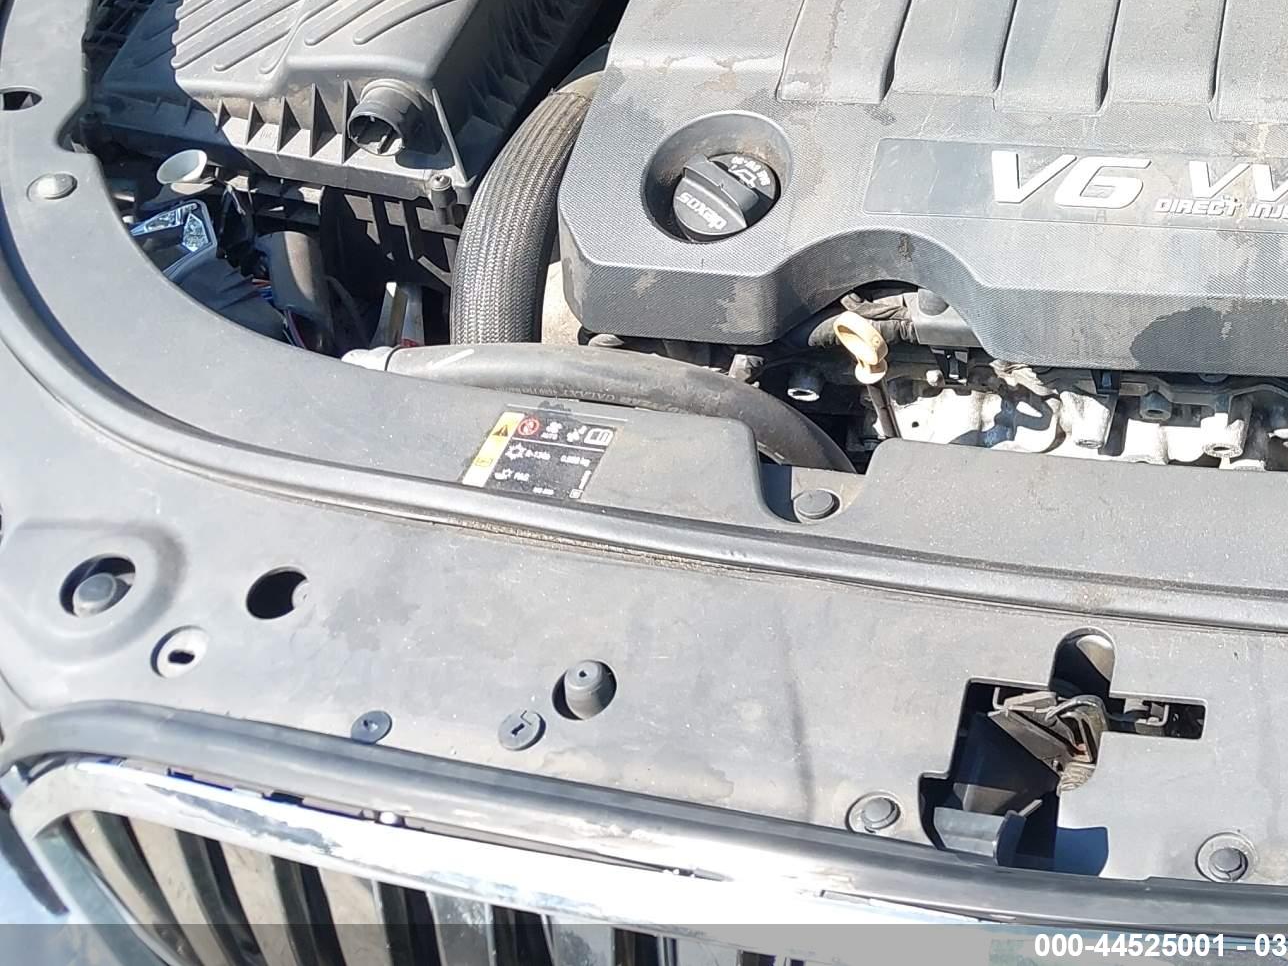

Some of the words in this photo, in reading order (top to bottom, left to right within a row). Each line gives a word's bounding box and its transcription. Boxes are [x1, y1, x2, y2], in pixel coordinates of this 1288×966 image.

[991, 150, 1152, 210] V6
[675, 191, 728, 230] dexos
[1155, 198, 1241, 218] DIRECT
